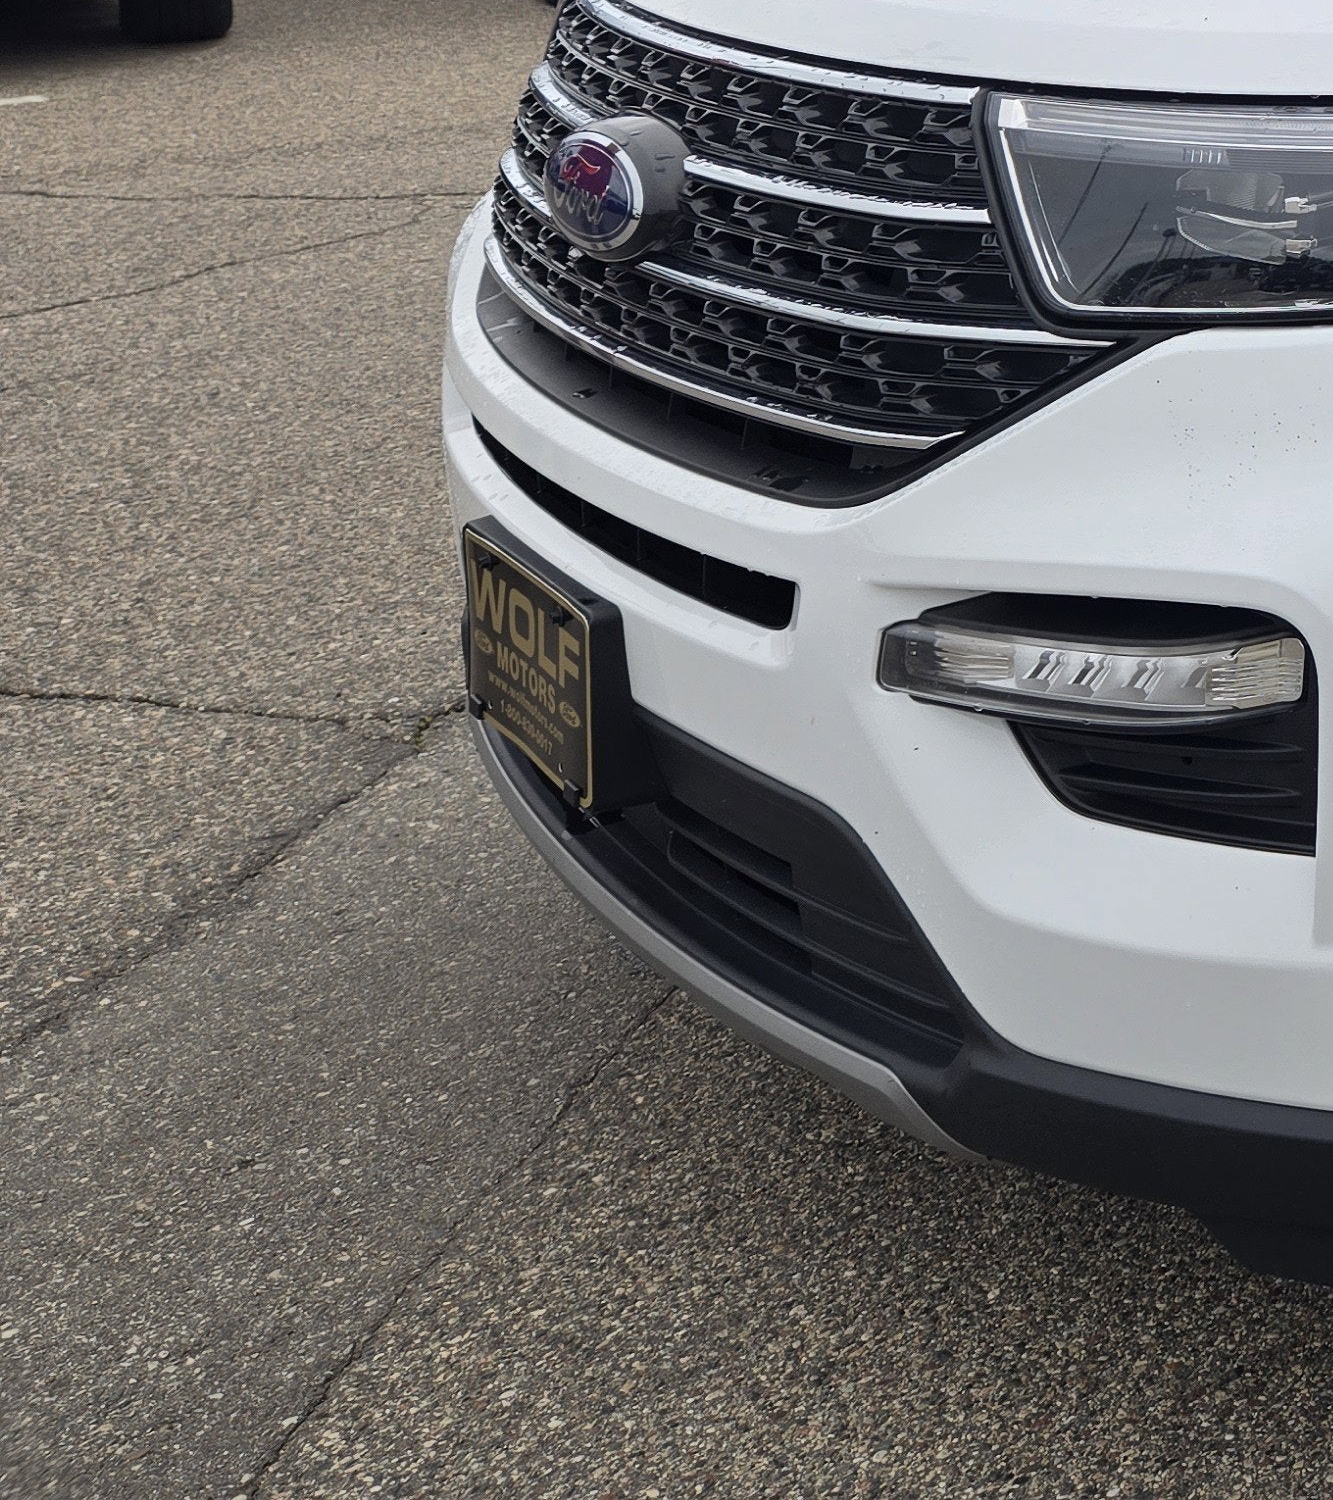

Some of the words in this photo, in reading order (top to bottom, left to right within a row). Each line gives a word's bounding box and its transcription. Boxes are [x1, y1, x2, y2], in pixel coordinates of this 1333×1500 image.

[553, 152, 611, 226] Ford
[470, 558, 580, 688] WOLF
[496, 641, 557, 714] MOTORS
